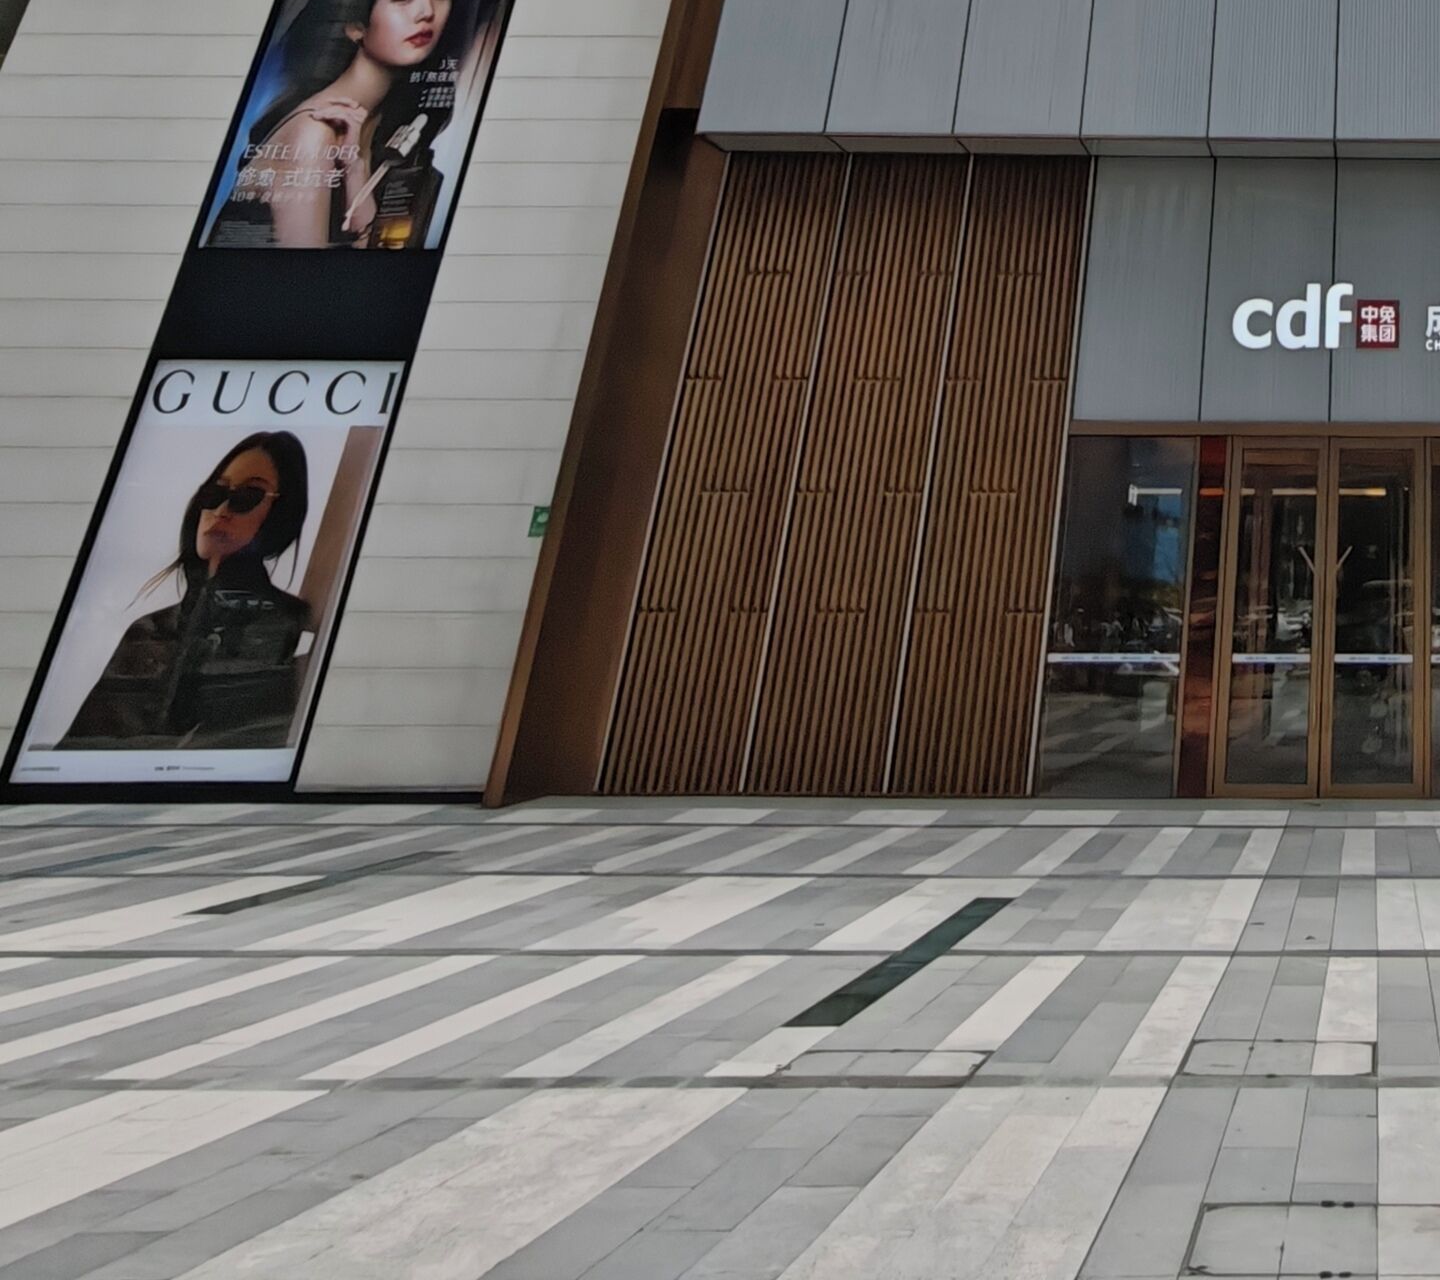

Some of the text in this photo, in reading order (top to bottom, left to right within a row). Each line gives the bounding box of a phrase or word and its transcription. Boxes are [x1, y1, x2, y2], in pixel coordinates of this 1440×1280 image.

[1232, 282, 1354, 350] cdf
[1361, 305, 1396, 323] 中免
[152, 369, 399, 415] GUCCI
